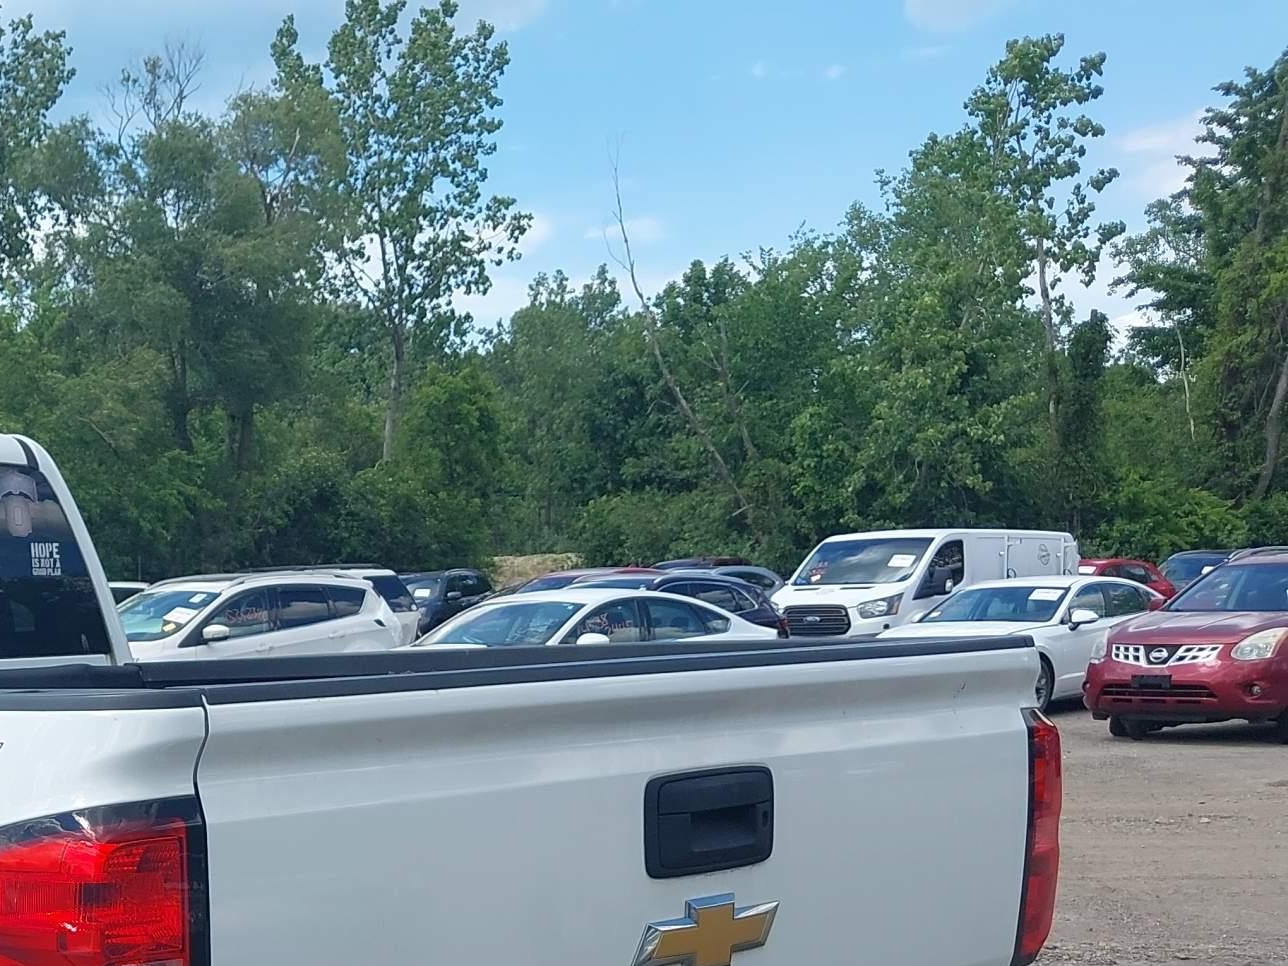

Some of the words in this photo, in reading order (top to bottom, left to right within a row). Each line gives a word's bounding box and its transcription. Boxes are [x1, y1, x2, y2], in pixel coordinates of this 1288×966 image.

[30, 542, 61, 558] HOPE
[31, 558, 40, 568] IS
[40, 558, 54, 568] NOT
